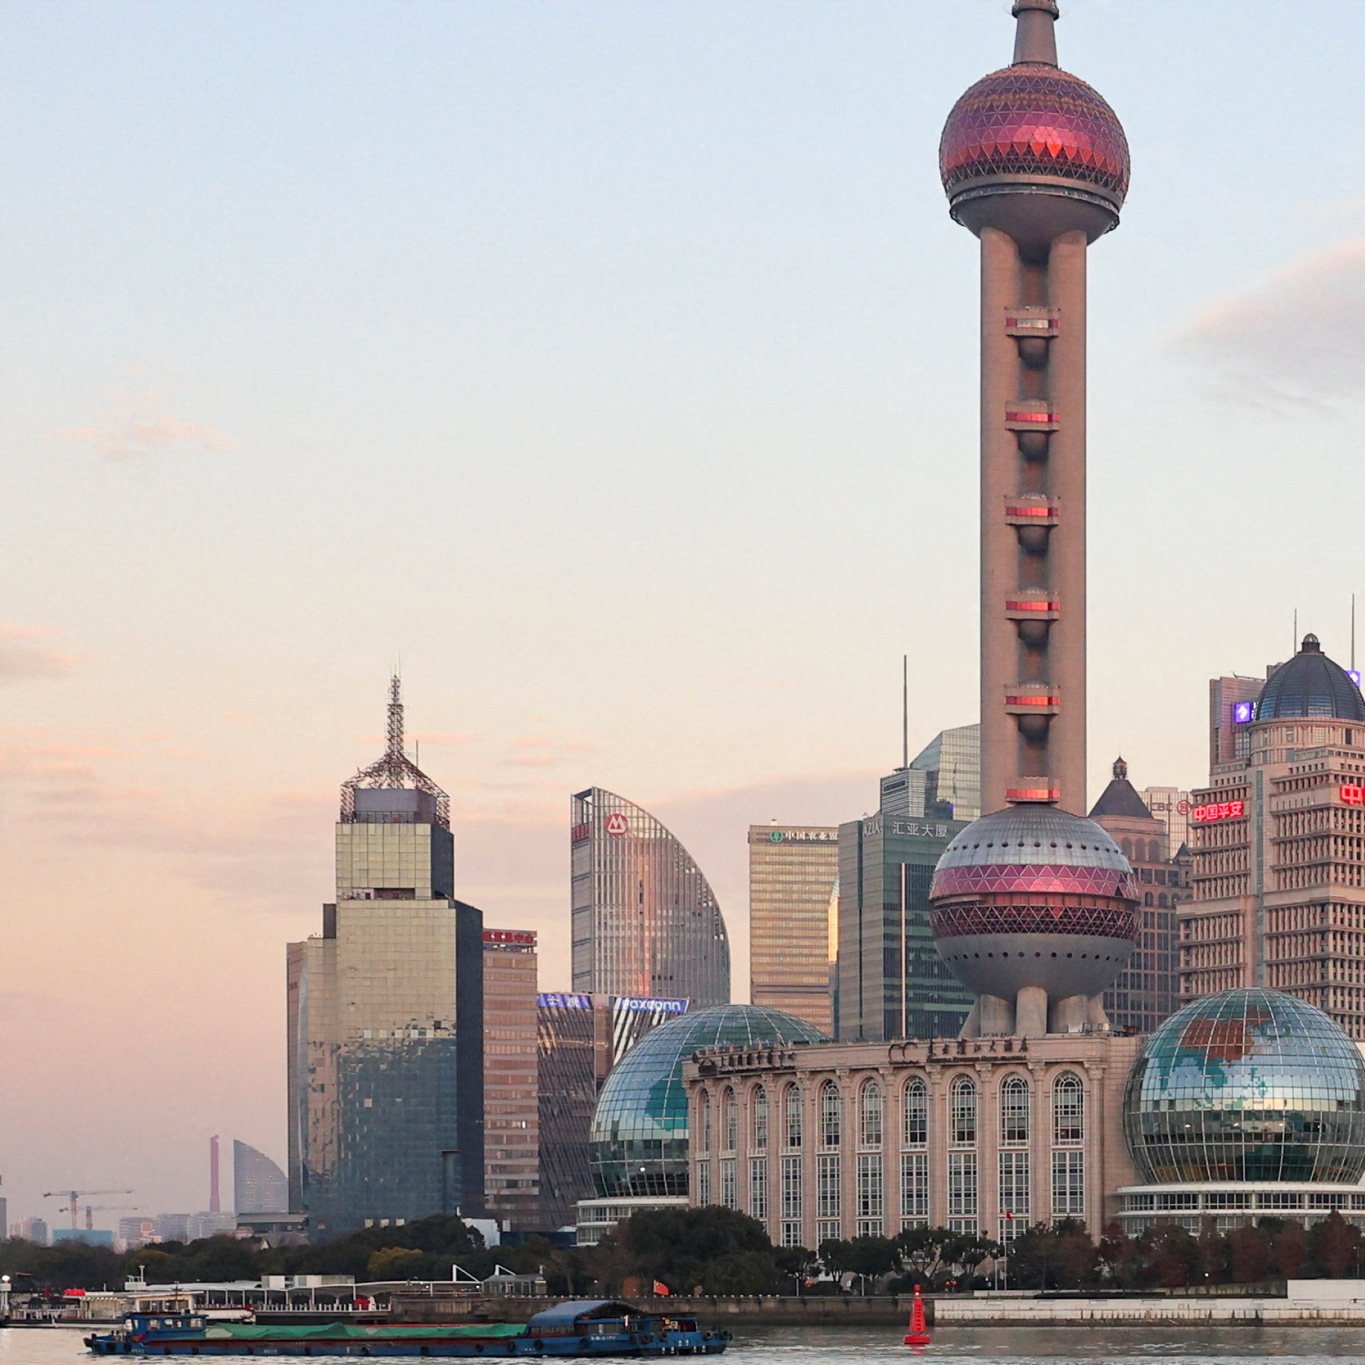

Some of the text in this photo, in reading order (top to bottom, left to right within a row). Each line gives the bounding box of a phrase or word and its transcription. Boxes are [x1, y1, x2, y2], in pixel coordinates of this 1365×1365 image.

[1194, 801, 1244, 822] 中国平安
[892, 821, 949, 838] 汇亚大厦
